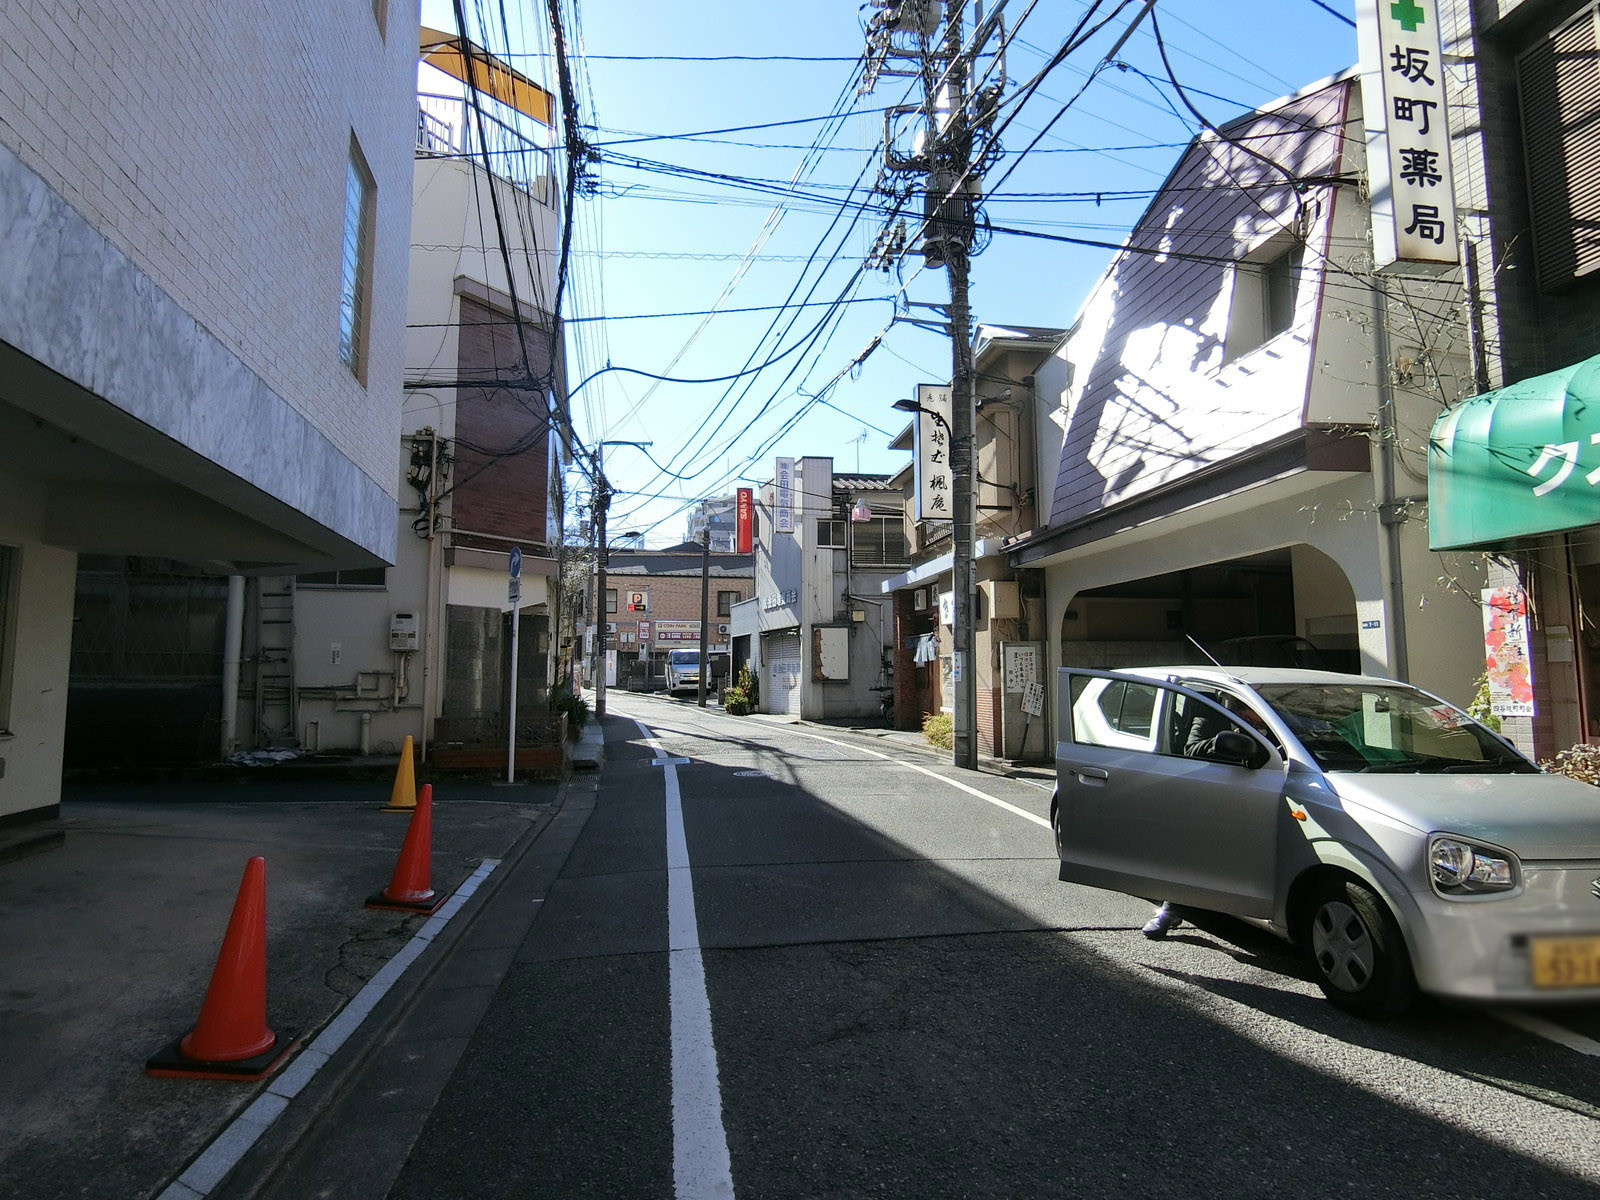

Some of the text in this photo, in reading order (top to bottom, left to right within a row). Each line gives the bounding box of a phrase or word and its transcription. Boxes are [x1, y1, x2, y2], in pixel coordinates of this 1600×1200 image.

[1389, 43, 1445, 245] 坂町薬局
[1526, 432, 1600, 498] ク
[739, 491, 748, 520] SANYO
[1493, 704, 1532, 713] 四谷坂町町会
